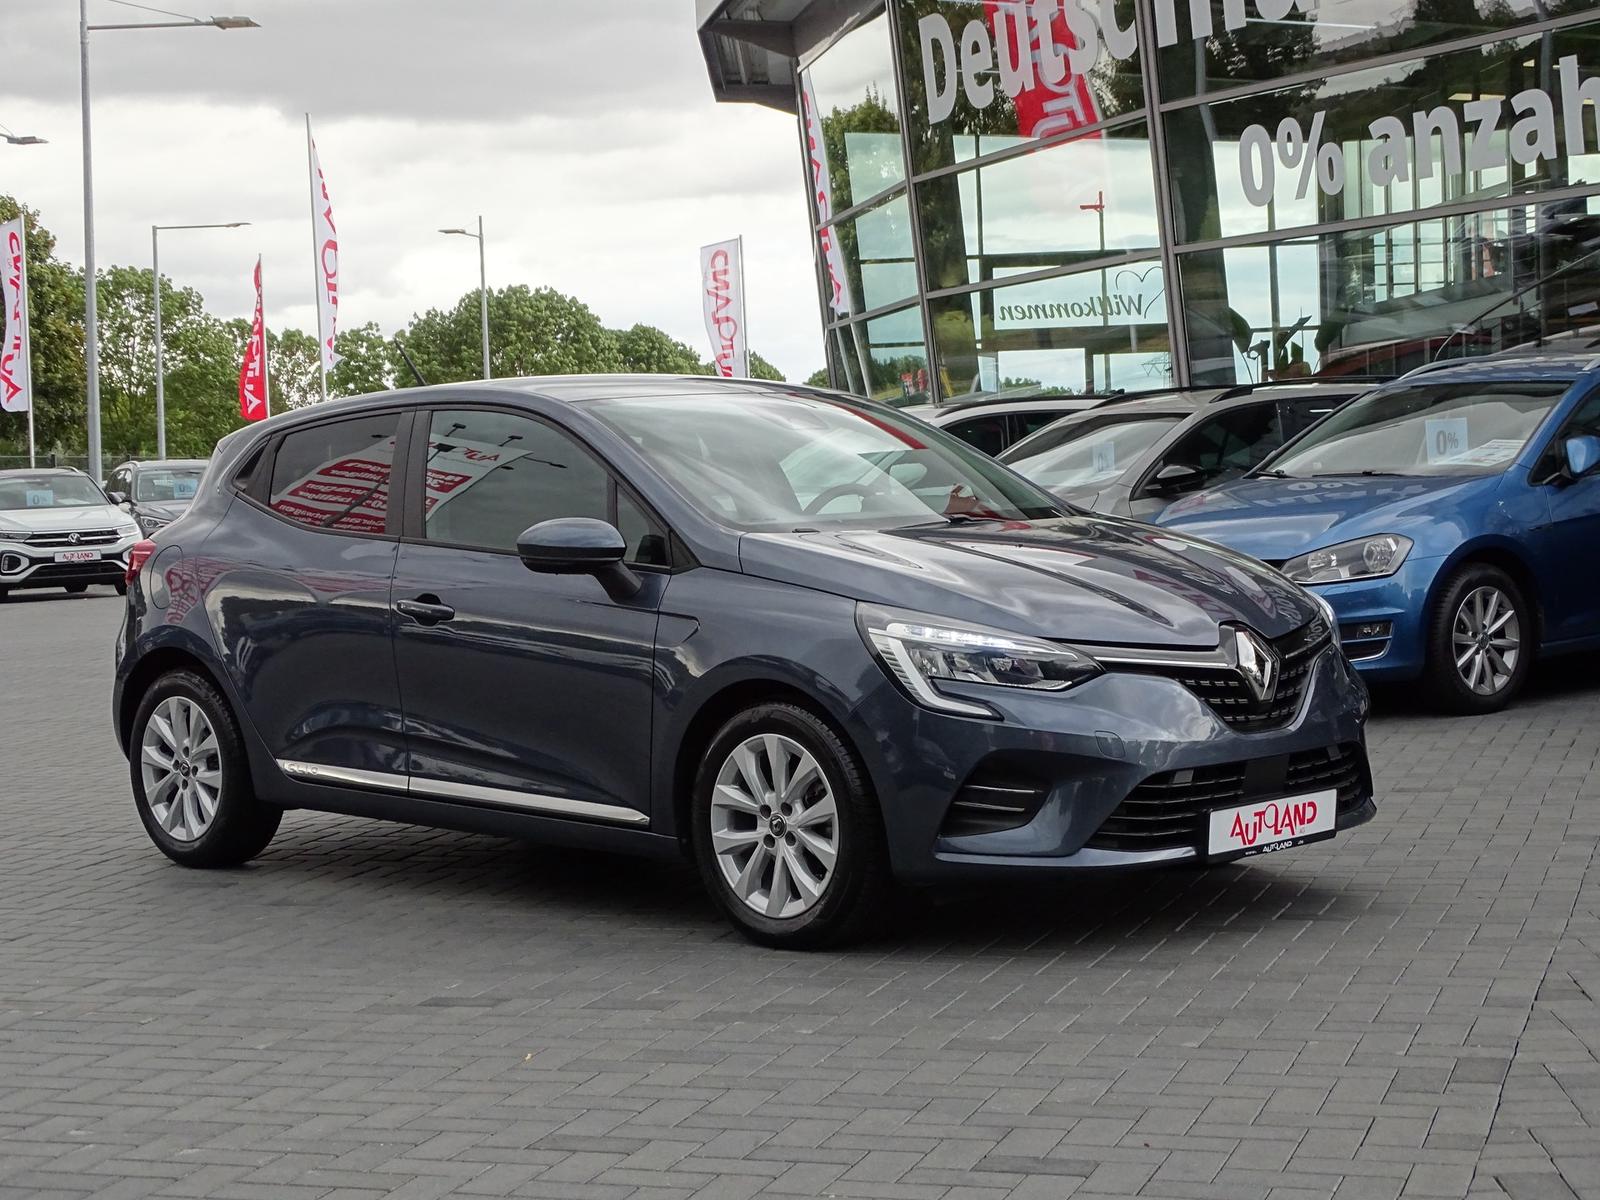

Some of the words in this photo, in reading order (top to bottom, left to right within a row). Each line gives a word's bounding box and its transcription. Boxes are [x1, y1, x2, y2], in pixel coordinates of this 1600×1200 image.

[1239, 110, 1345, 208] 0%
[1435, 431, 1459, 455] 0%
[1229, 801, 1318, 846] AUTOLAND
[1262, 840, 1293, 853] AUTOLAND
